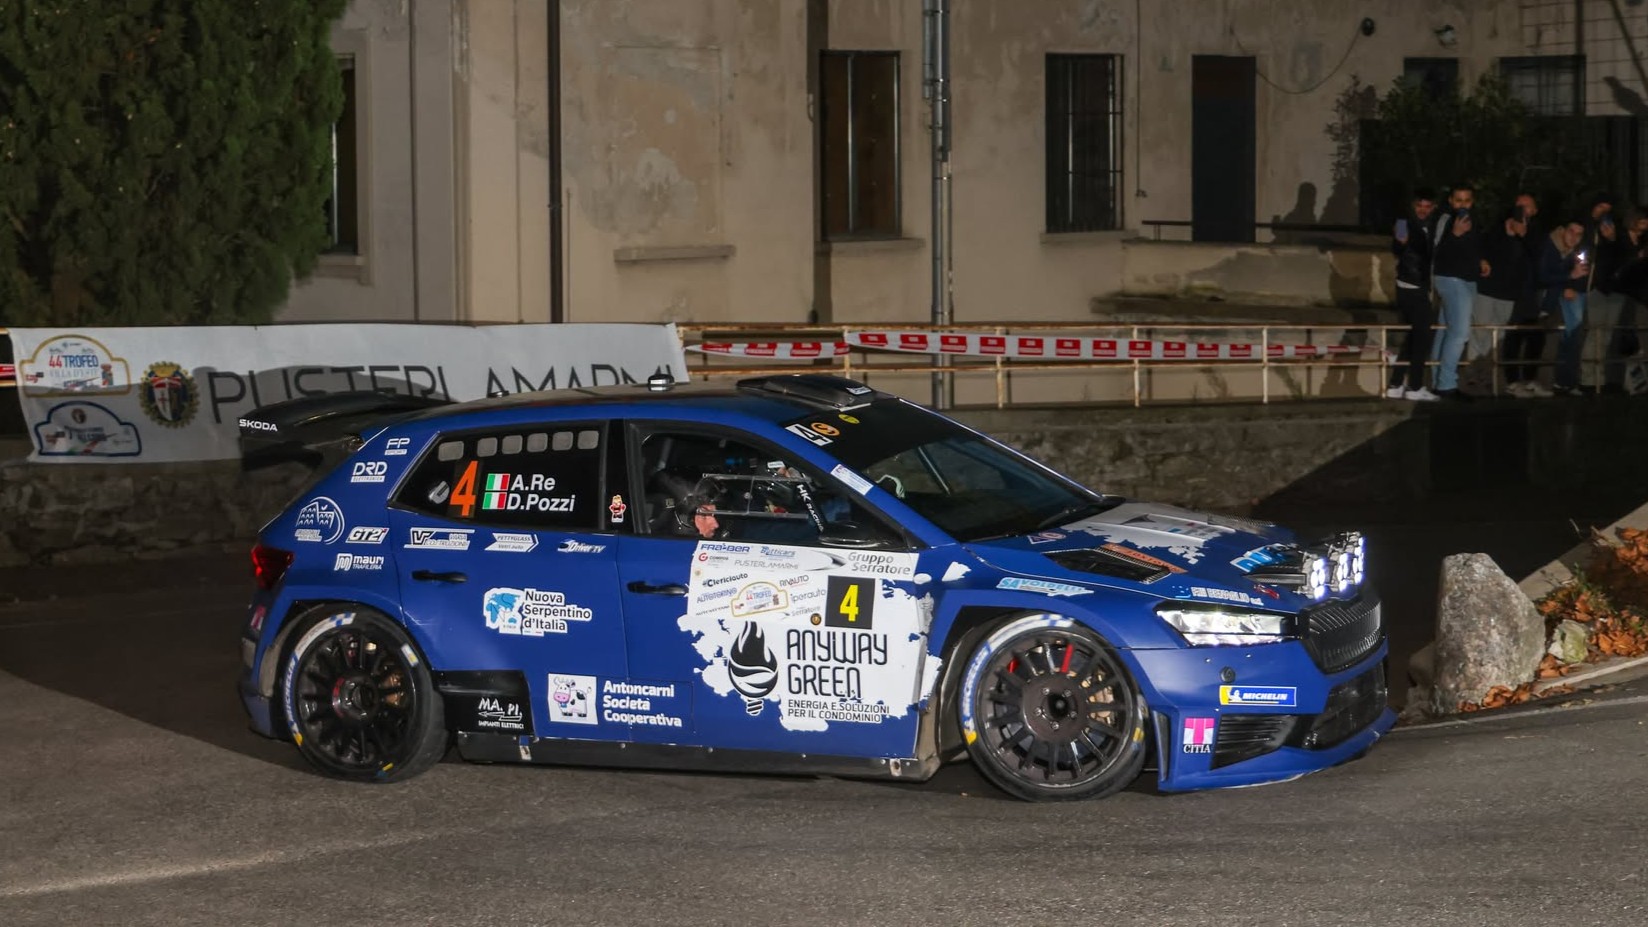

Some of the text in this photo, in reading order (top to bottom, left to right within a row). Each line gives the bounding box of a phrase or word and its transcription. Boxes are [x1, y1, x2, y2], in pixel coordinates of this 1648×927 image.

[386, 438, 410, 449] FP
[352, 461, 388, 476] DRD
[449, 460, 479, 516] 4
[510, 473, 556, 491] A.Re
[506, 493, 576, 512] D.Pozzi
[848, 551, 895, 565] Gruppo
[851, 563, 911, 576] Serratore
[525, 590, 563, 604] Nuova
[840, 585, 859, 622] 4
[523, 604, 591, 619] Serpentino
[523, 618, 566, 631] d'Italia
[603, 679, 675, 698] Antoncarni
[602, 695, 651, 711] Società
[1242, 692, 1288, 701] MICHELIN
[788, 699, 890, 715] ENERGIA E SOLUZIONI
[603, 709, 683, 728] Cooperativa
[788, 708, 881, 723] PER IL CONDOMINIO
